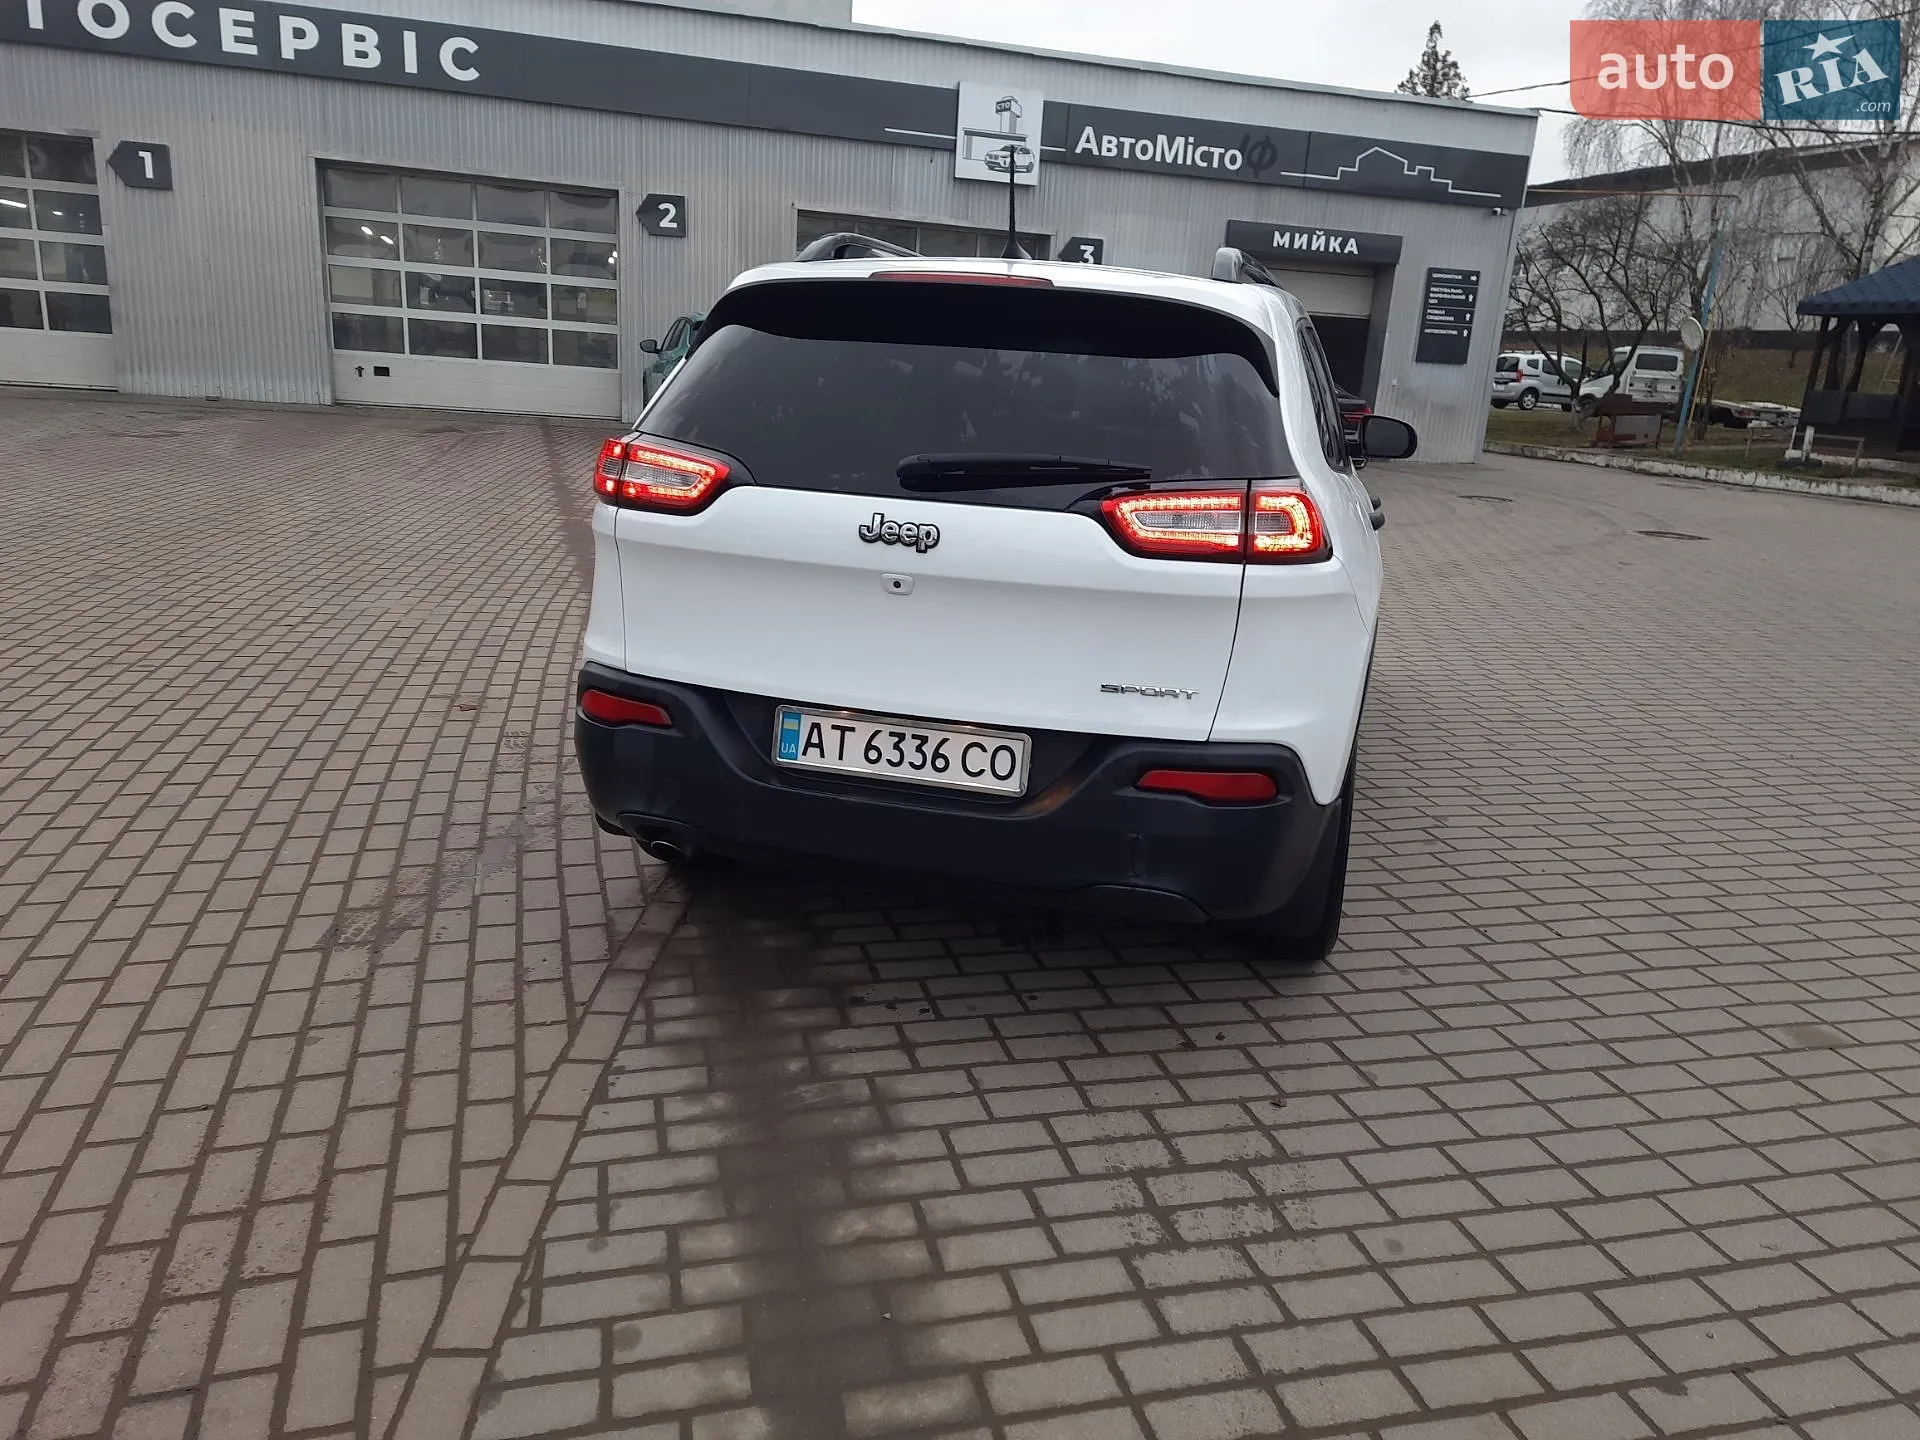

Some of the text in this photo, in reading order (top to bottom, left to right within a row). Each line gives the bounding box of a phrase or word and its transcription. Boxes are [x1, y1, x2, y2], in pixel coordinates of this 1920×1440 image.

[1074, 126, 1243, 171] АвтоМісто
[138, 150, 154, 179] 1
[658, 202, 678, 229] 2
[1079, 244, 1095, 264] 3
[1272, 229, 1359, 255] МИЙКА
[859, 512, 940, 554] Jeep
[1100, 683, 1200, 700] SPORT
[781, 743, 797, 754] UA
[801, 722, 1017, 781] AT 6336 CO
